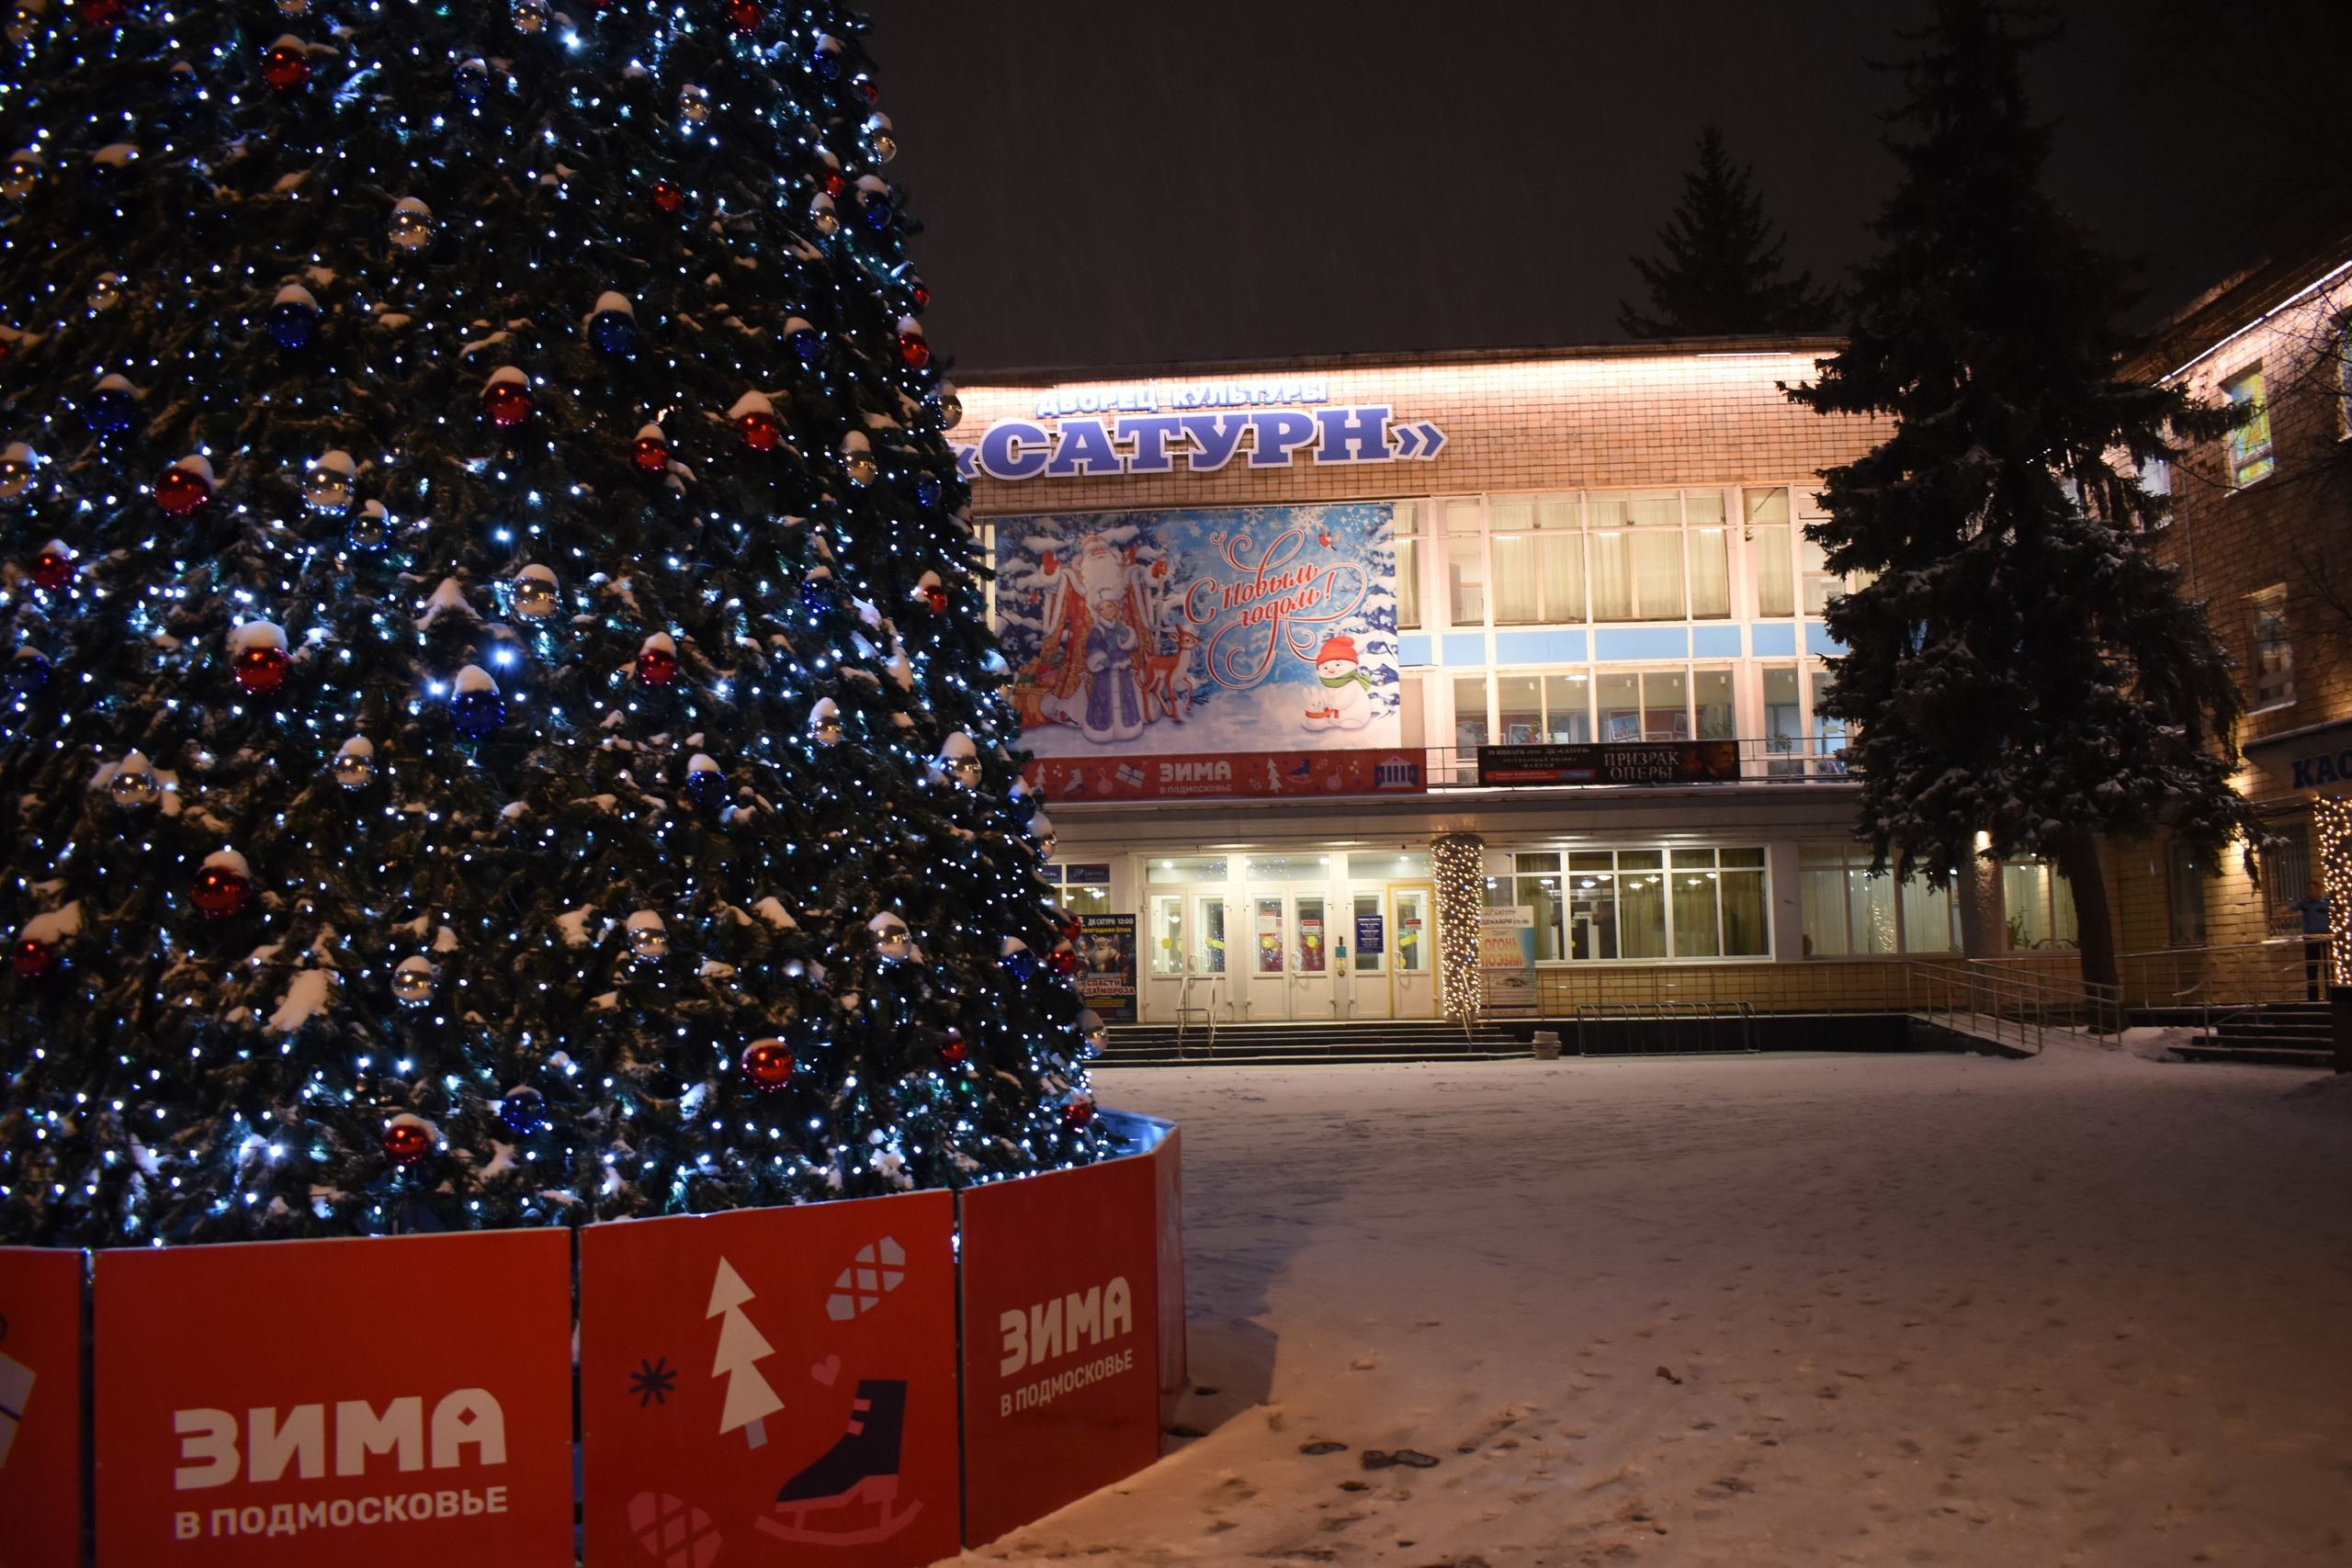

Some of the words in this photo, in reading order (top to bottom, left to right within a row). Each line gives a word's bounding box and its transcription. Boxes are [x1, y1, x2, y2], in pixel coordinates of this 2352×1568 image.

[1036, 387, 1159, 418] ДВОРЕЦ
[1171, 379, 1329, 409] КУЛЬТУРЫ
[1184, 578, 1216, 624] С
[1218, 547, 1319, 611] Новым
[1604, 751, 1680, 767] ПРИЗРАК
[1159, 761, 1231, 782] ЗИМА
[1610, 766, 1673, 780] ОПЕРЫ
[1168, 784, 1232, 794] ПОДМОСКОВЬЕ
[1096, 918, 1115, 926] САТУРН
[1484, 938, 1519, 952] ОГОНЬ
[1481, 953, 1522, 966] ПОЭЗИИ
[1080, 987, 1098, 997] ЕДА
[1100, 986, 1135, 995] МОРОЗА
[1000, 1276, 1132, 1377] ЗИМА
[1000, 1393, 1012, 1417] В
[1015, 1348, 1133, 1409] ПОДМОСКОВЬЕ
[174, 1387, 507, 1490] ЗИМА
[175, 1511, 200, 1540] В
[211, 1486, 508, 1537] ПОДМОСКОВЬЕ
